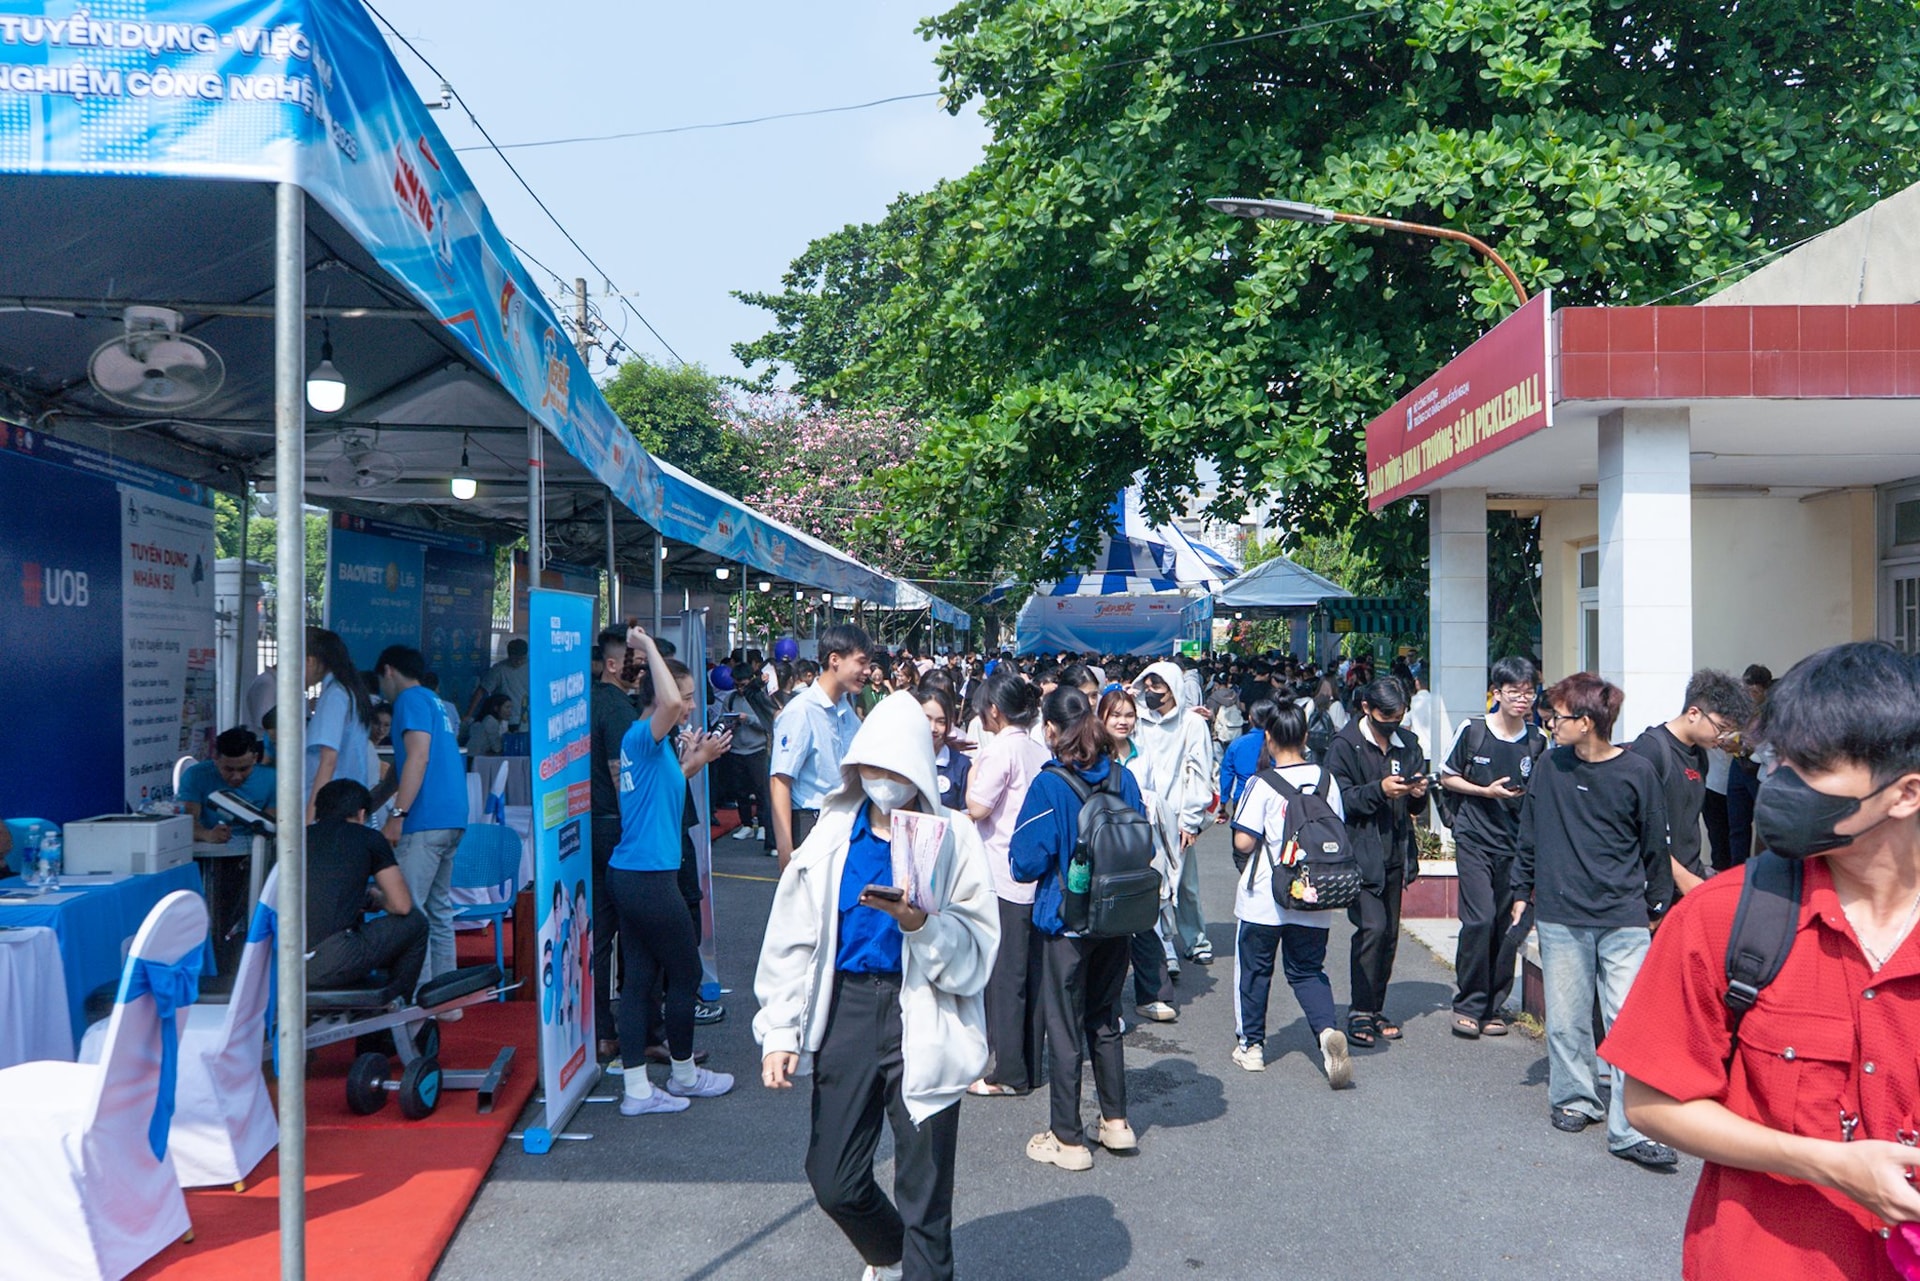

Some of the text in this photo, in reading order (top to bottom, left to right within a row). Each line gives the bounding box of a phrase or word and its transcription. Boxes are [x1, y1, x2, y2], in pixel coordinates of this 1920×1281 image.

[0, 8, 114, 48] TUYỂN
[119, 22, 218, 57] DỤNG
[234, 22, 312, 62] VIỆC
[126, 66, 224, 101] CÔNG
[1403, 444, 1421, 482] KHAI
[1454, 407, 1474, 454] SÂN
[1475, 373, 1543, 444] PICKLEBALL
[133, 567, 160, 588] NHÂN
[164, 549, 189, 571] DỤNG
[46, 567, 89, 607] UOB
[1391, 759, 1401, 775] B
